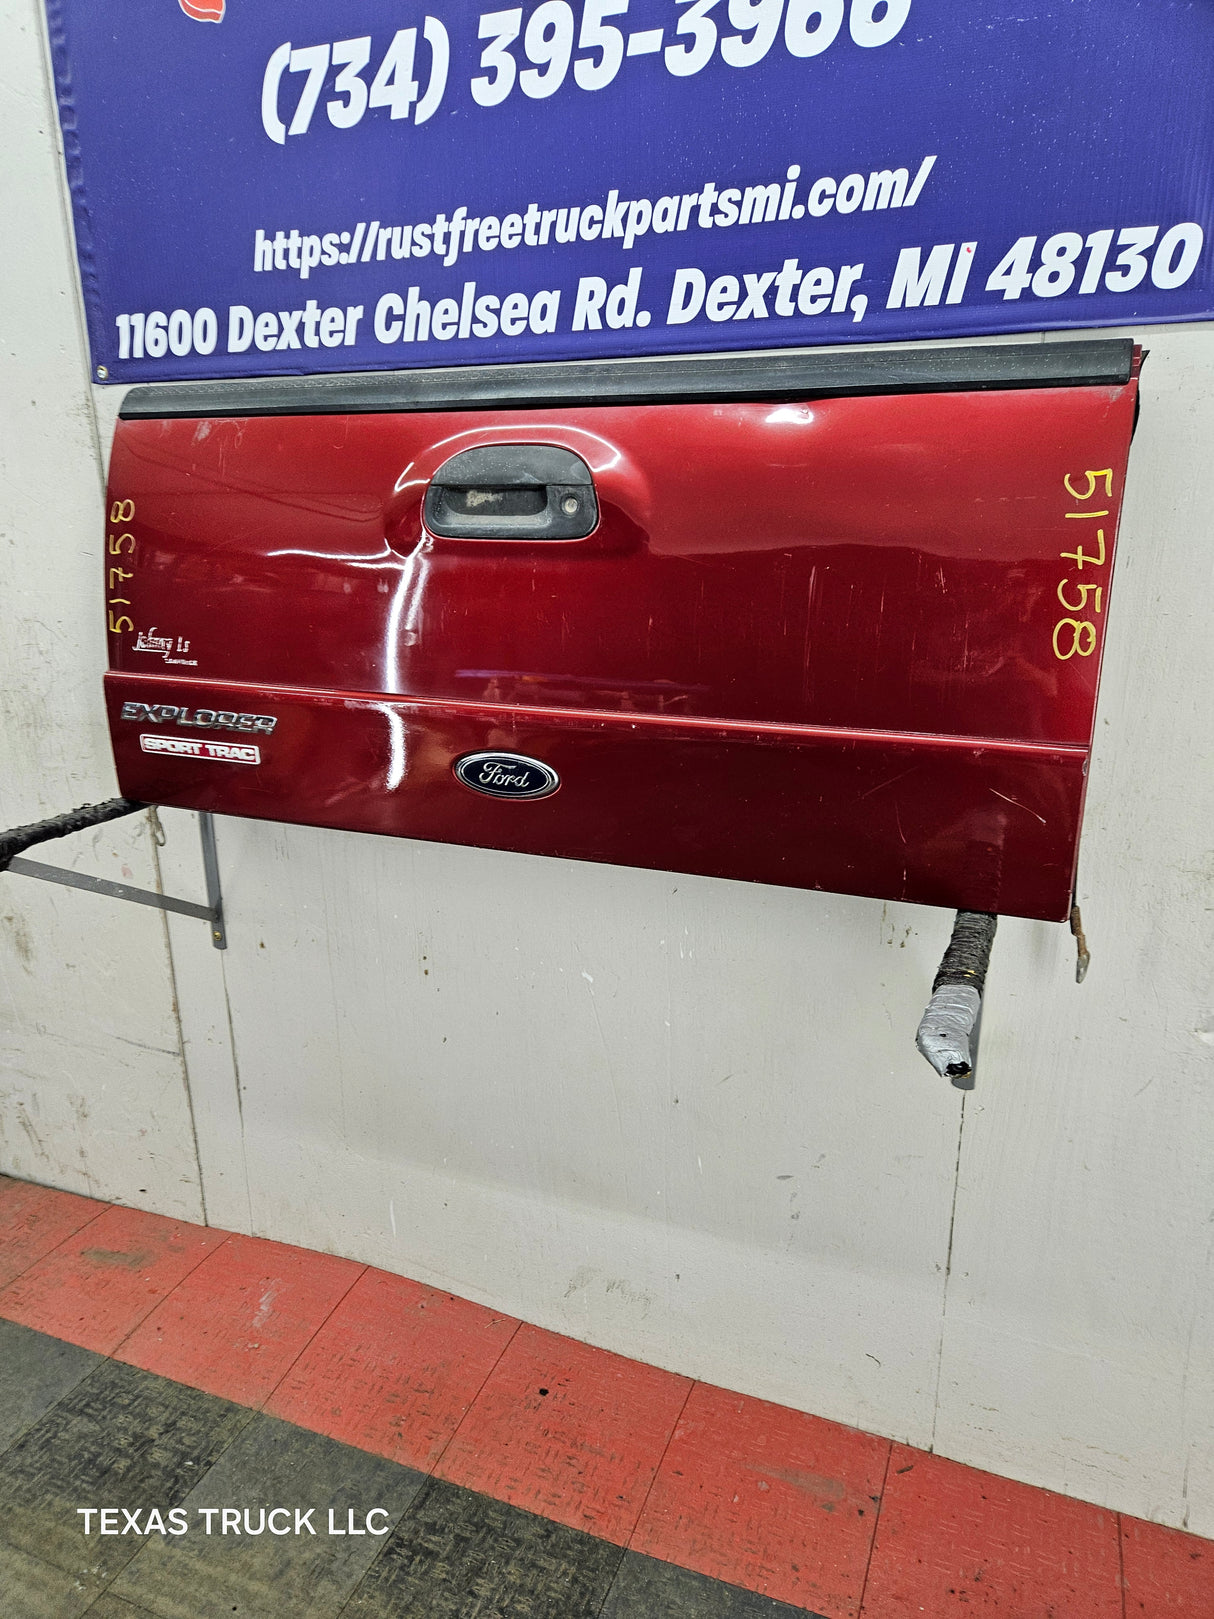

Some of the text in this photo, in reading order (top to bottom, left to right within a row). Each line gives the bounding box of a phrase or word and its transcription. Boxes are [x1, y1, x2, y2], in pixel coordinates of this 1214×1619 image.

[261, 15, 450, 145] (734)
[253, 155, 938, 280] https://rustfreetruckpartsmi.com/
[115, 221, 1204, 360] 11600 Dexter Chelsea Rd. Dexter, MI 48130
[108, 498, 137, 634] 51758
[1052, 467, 1114, 661] 51758
[120, 701, 278, 735] EXPLORER
[142, 737, 257, 761] SPORT TRAC
[478, 761, 531, 788] Ford
